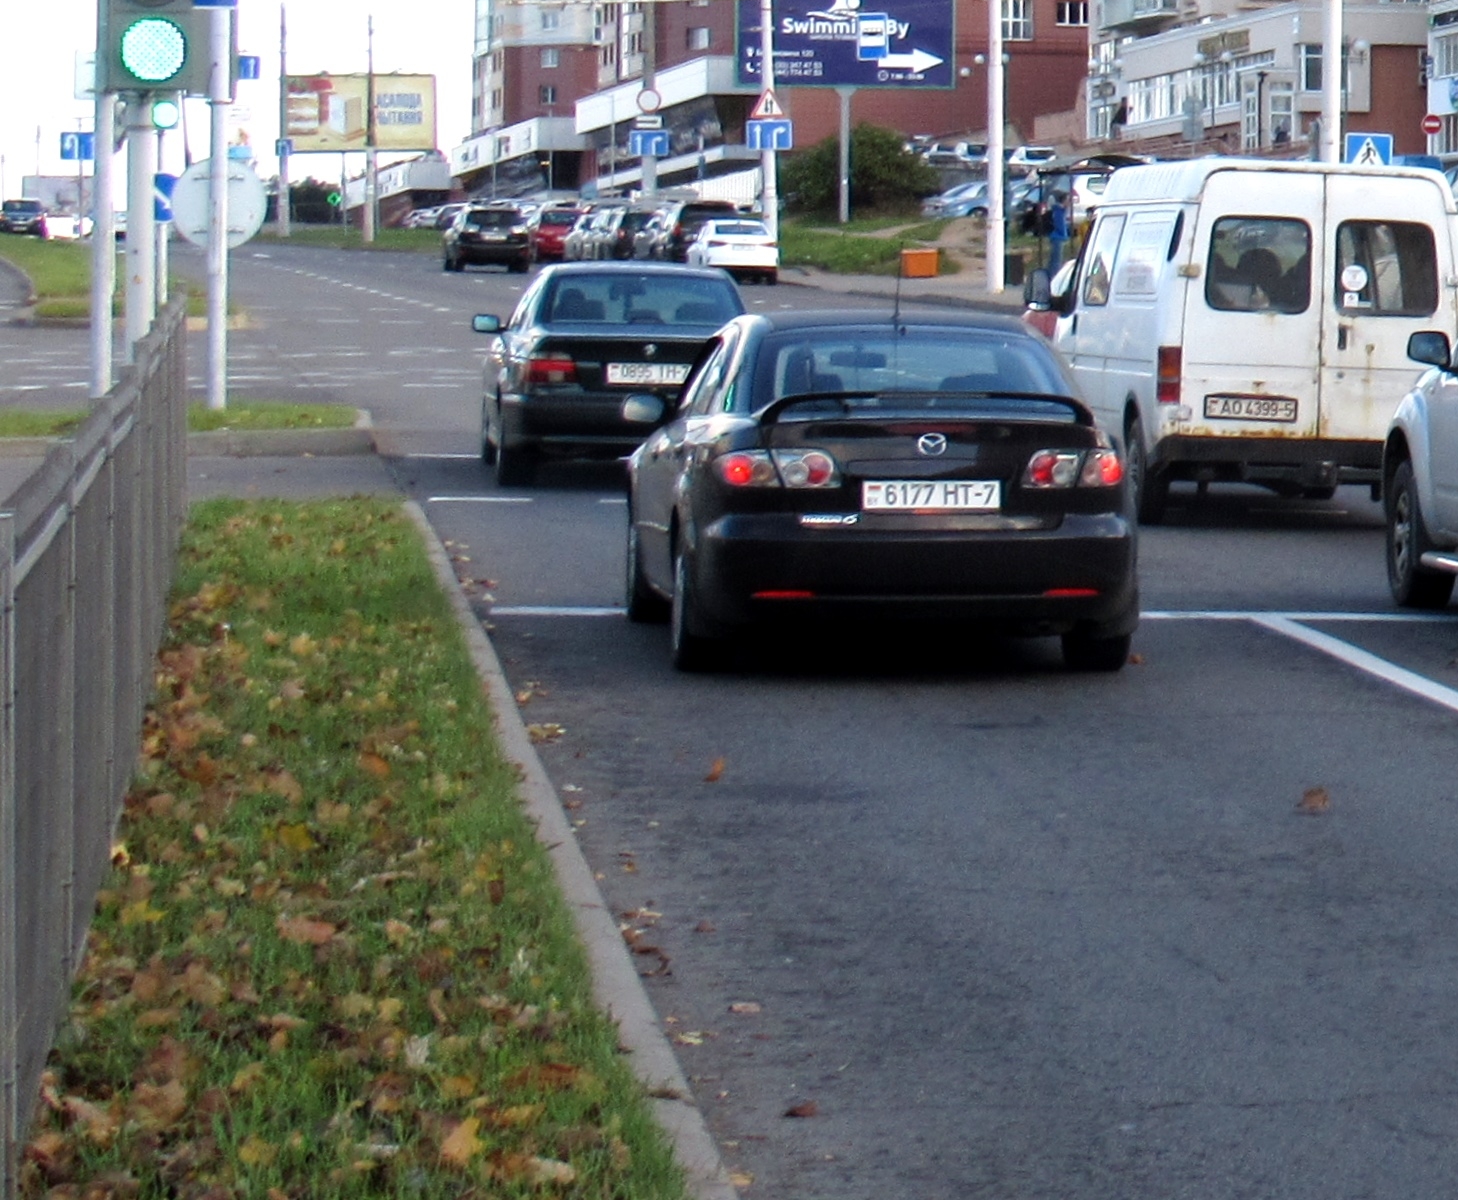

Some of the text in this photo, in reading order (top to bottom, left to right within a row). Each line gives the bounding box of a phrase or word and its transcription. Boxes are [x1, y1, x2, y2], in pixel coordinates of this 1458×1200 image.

[782, 16, 856, 35] Swimmi
[885, 484, 996, 506] 6177 HT-7
